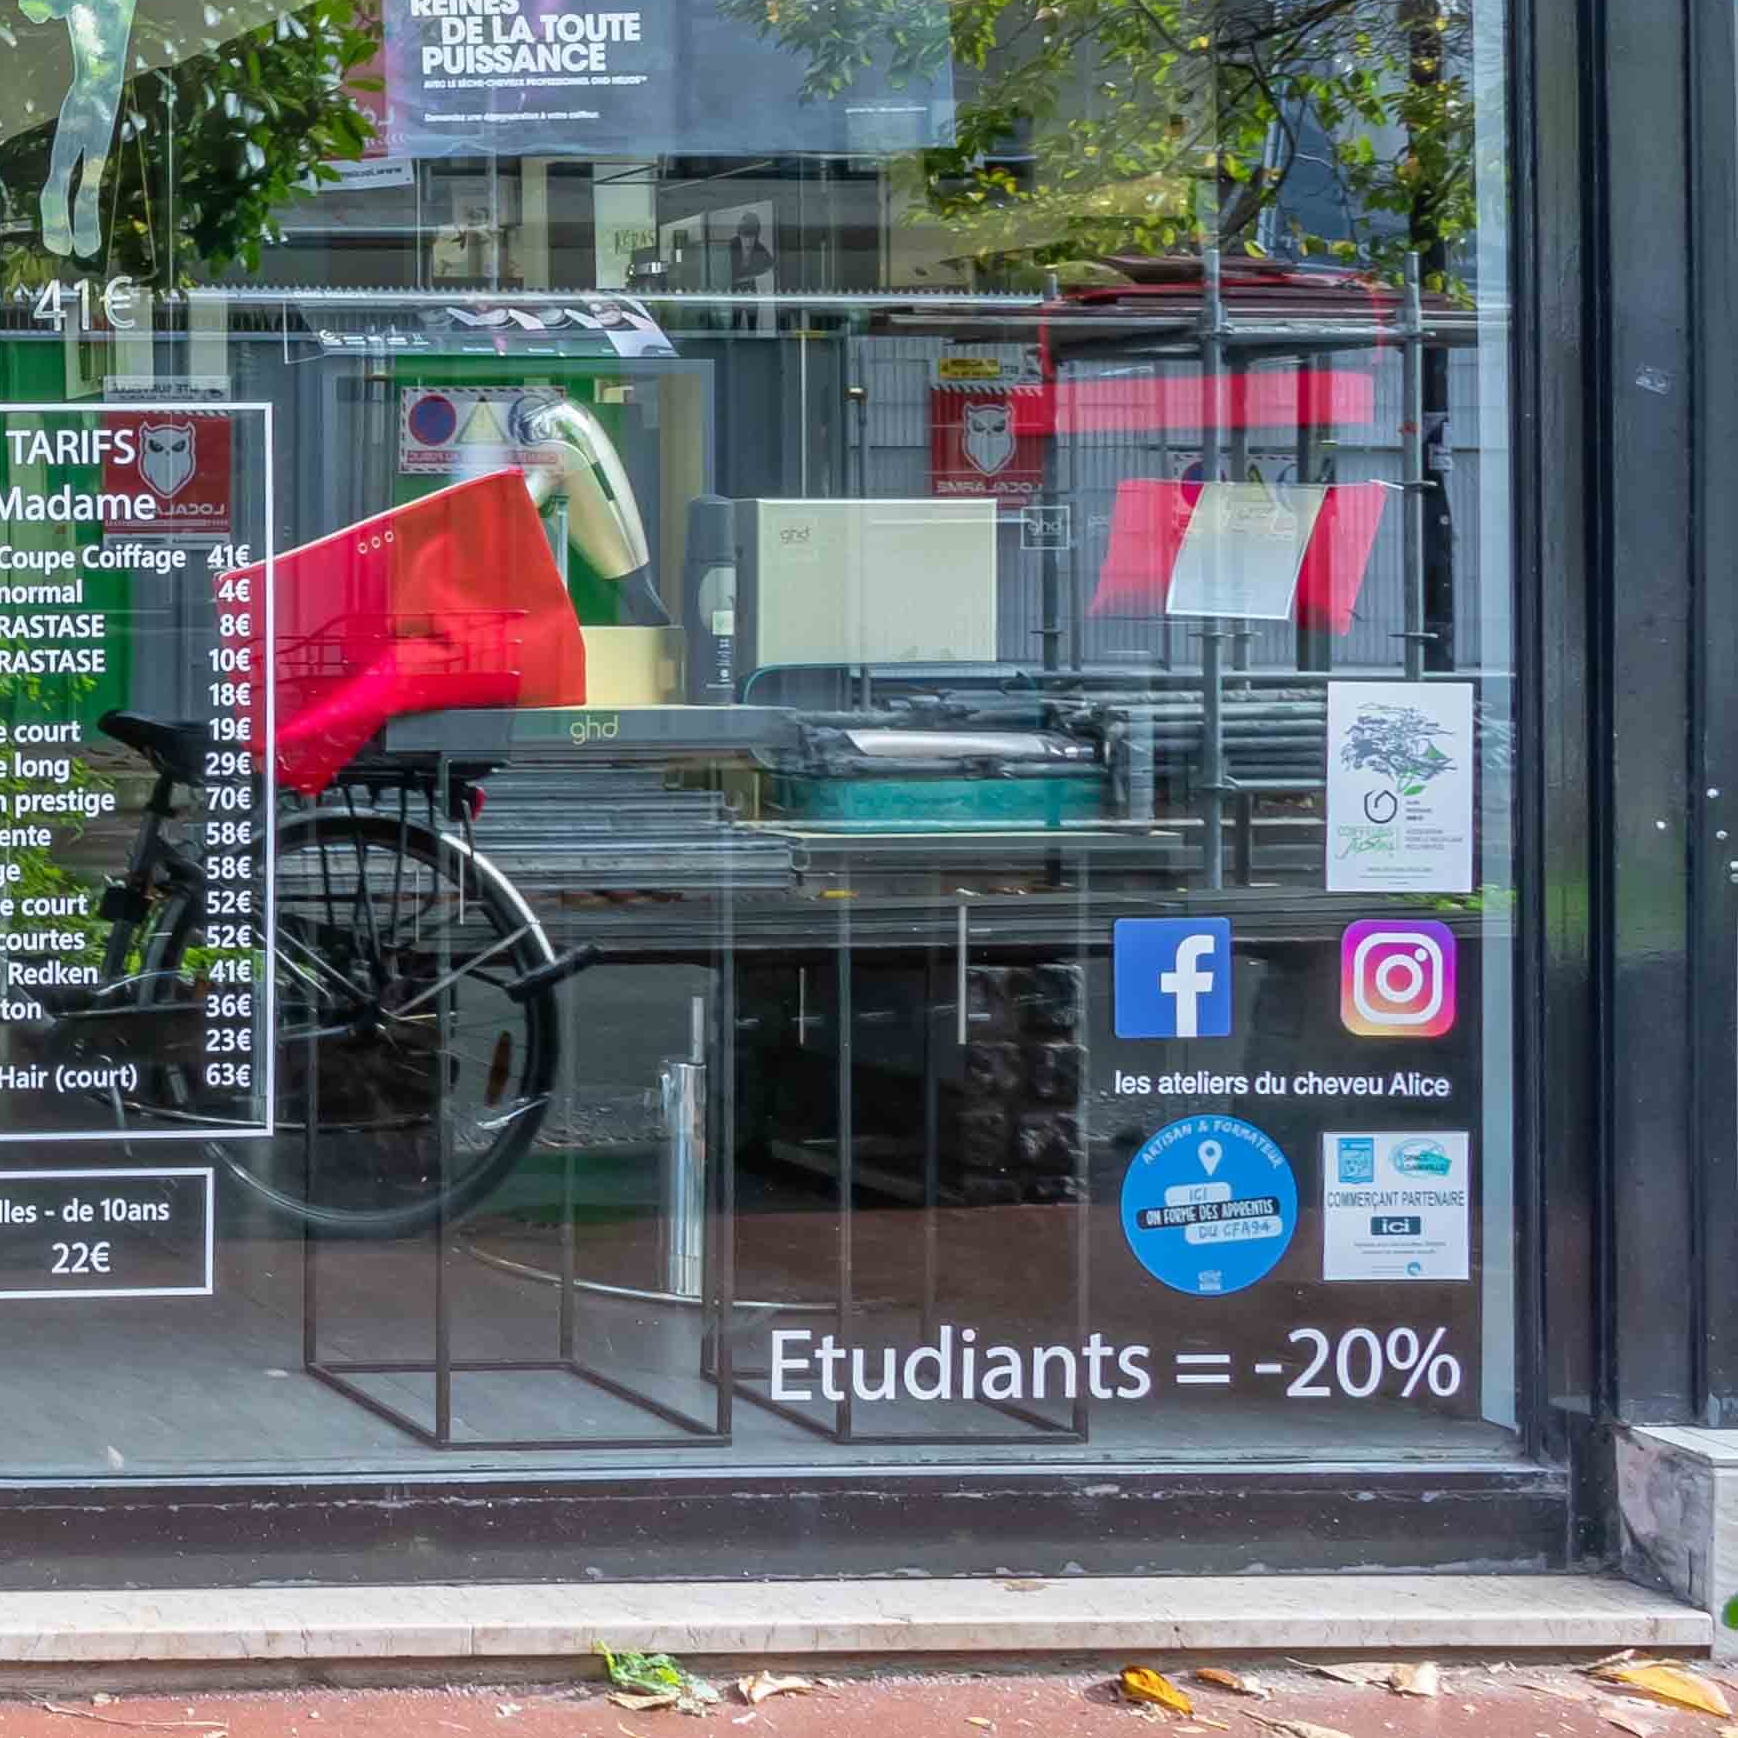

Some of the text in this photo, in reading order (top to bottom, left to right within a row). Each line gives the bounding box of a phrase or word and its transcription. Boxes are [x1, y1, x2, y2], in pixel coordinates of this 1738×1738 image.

[441, 13, 642, 44] DE LA TOUTE
[422, 43, 607, 74] PUISSANCE
[32, 275, 136, 332] 41€
[5, 430, 136, 465] TARIFS
[82, 544, 186, 574] Coiffage
[207, 544, 251, 570] 41€
[218, 579, 251, 603] 4€
[219, 613, 251, 637] 8€
[208, 647, 251, 673] 10€
[208, 682, 252, 707] 18€
[570, 714, 619, 744] ghd
[15, 755, 71, 782] long
[205, 752, 252, 776] 29€
[15, 789, 115, 816] prestige
[205, 787, 252, 811] 70€
[205, 925, 252, 949] 52€
[205, 1028, 252, 1053] 23€
[54, 1063, 138, 1093] (court)
[205, 1063, 252, 1088] 63€
[1115, 1070, 1450, 1097] les ateliers du cheveu Alice
[1140, 1123, 1193, 1166] ARTISAN
[1213, 1119, 1285, 1170] FORMATEUR
[1188, 1187, 1208, 1202] ICI
[1326, 1190, 1465, 1211] COMMERÇANT PARTENAIRE
[62, 1197, 94, 1223] de
[100, 1197, 170, 1223] 10ans
[1146, 1198, 1274, 1226] ON FORME DES APPRENTIS
[1381, 1218, 1411, 1233] ici
[51, 1241, 111, 1274] 22€
[771, 1325, 1461, 1402] Etudiants = -20%
